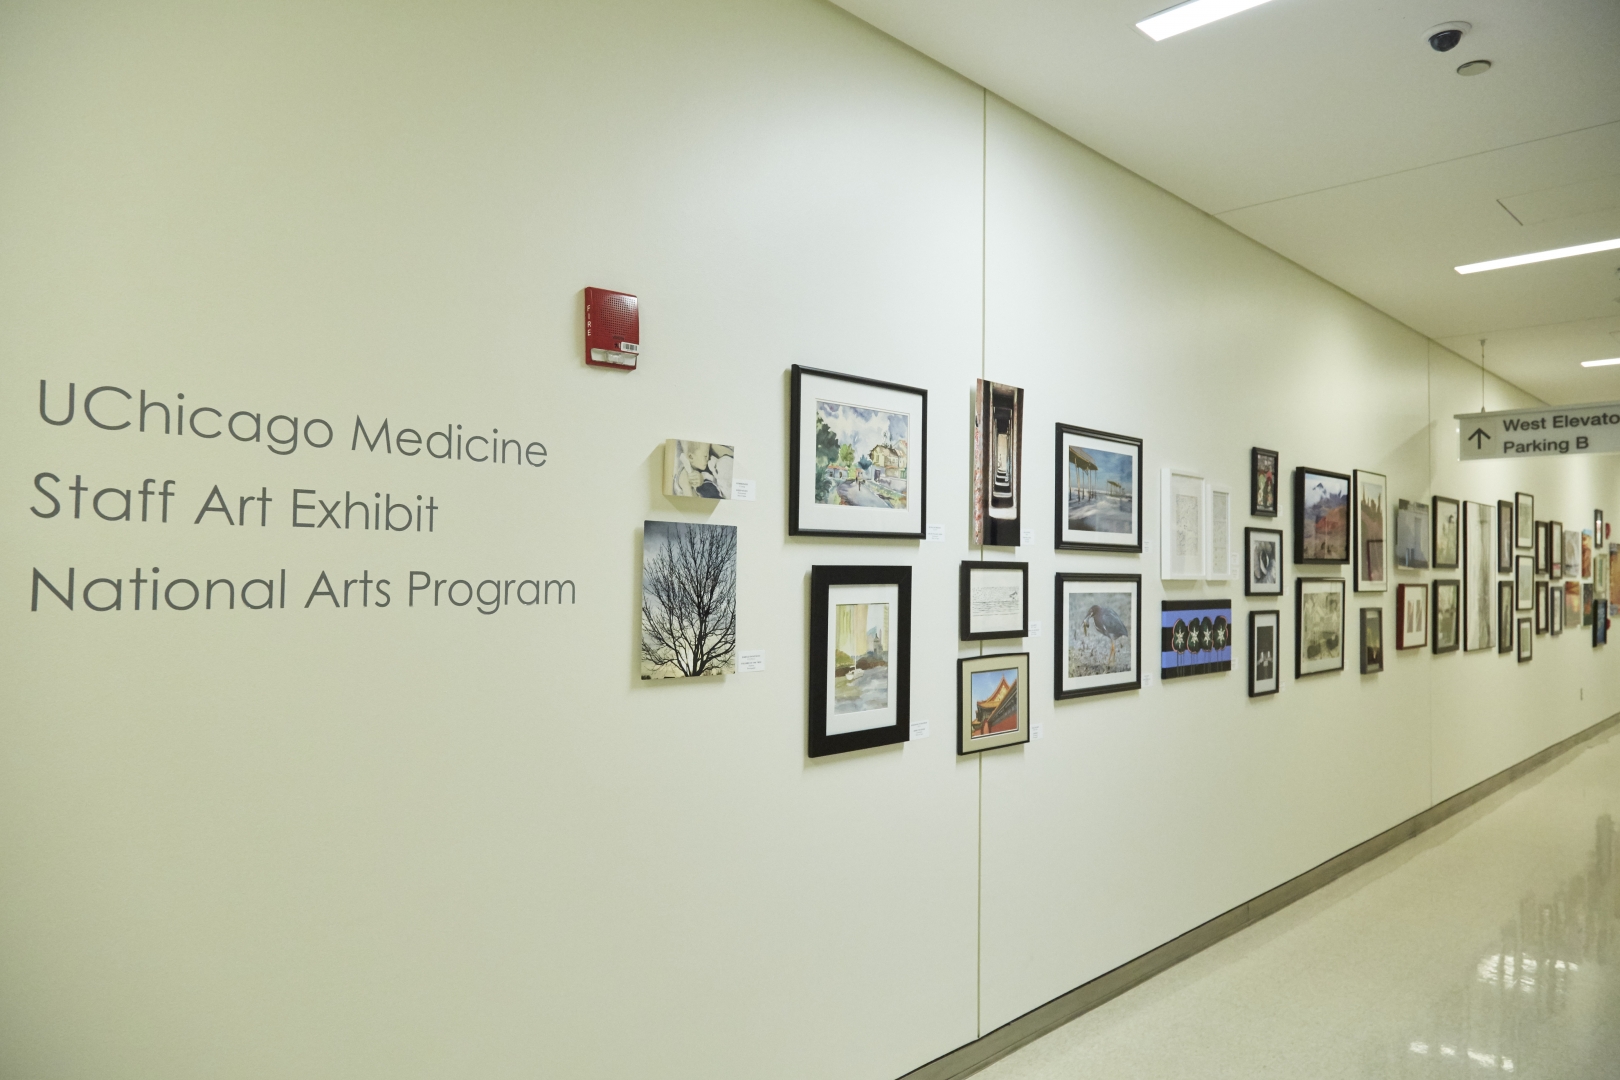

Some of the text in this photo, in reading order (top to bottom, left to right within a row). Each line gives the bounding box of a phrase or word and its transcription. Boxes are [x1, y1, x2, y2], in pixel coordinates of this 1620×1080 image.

[39, 379, 548, 468] UChicago Medicine
[1503, 418, 1546, 431] West
[1503, 436, 1589, 454] Parking B
[29, 472, 439, 533] Staff Art Exhibit
[30, 567, 576, 615] National Arts Program
